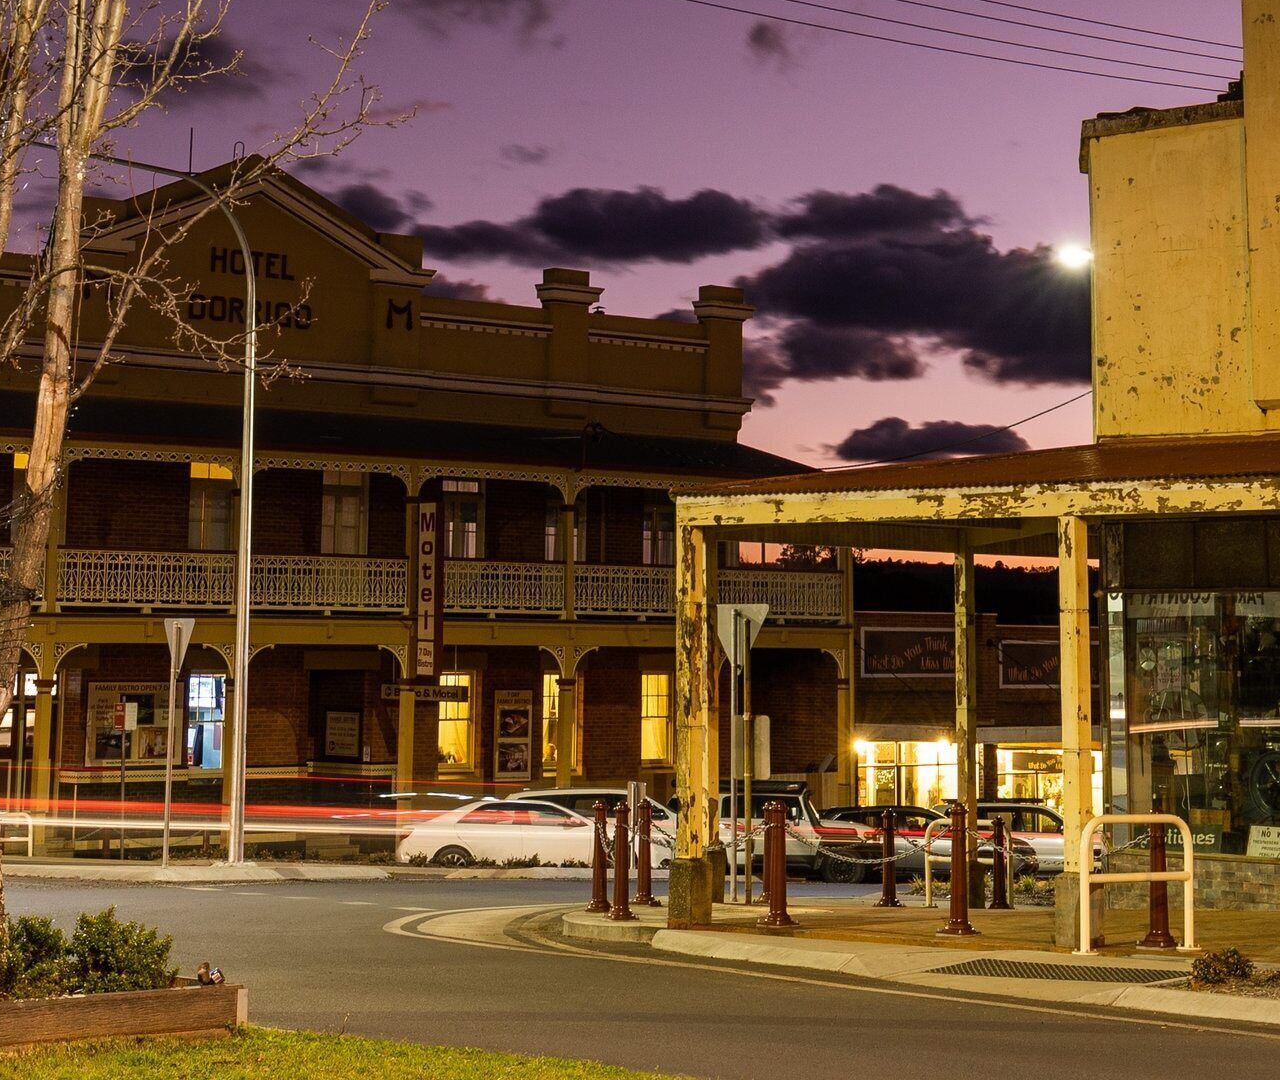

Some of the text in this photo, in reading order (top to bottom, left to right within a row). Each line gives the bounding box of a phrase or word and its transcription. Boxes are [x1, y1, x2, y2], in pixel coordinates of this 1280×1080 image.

[210, 246, 295, 281] HOTEL
[421, 512, 435, 629] Motel
[423, 648, 432, 658] Day
[904, 643, 922, 661] You
[432, 689, 458, 698] Motel
[1261, 830, 1271, 838] NO
